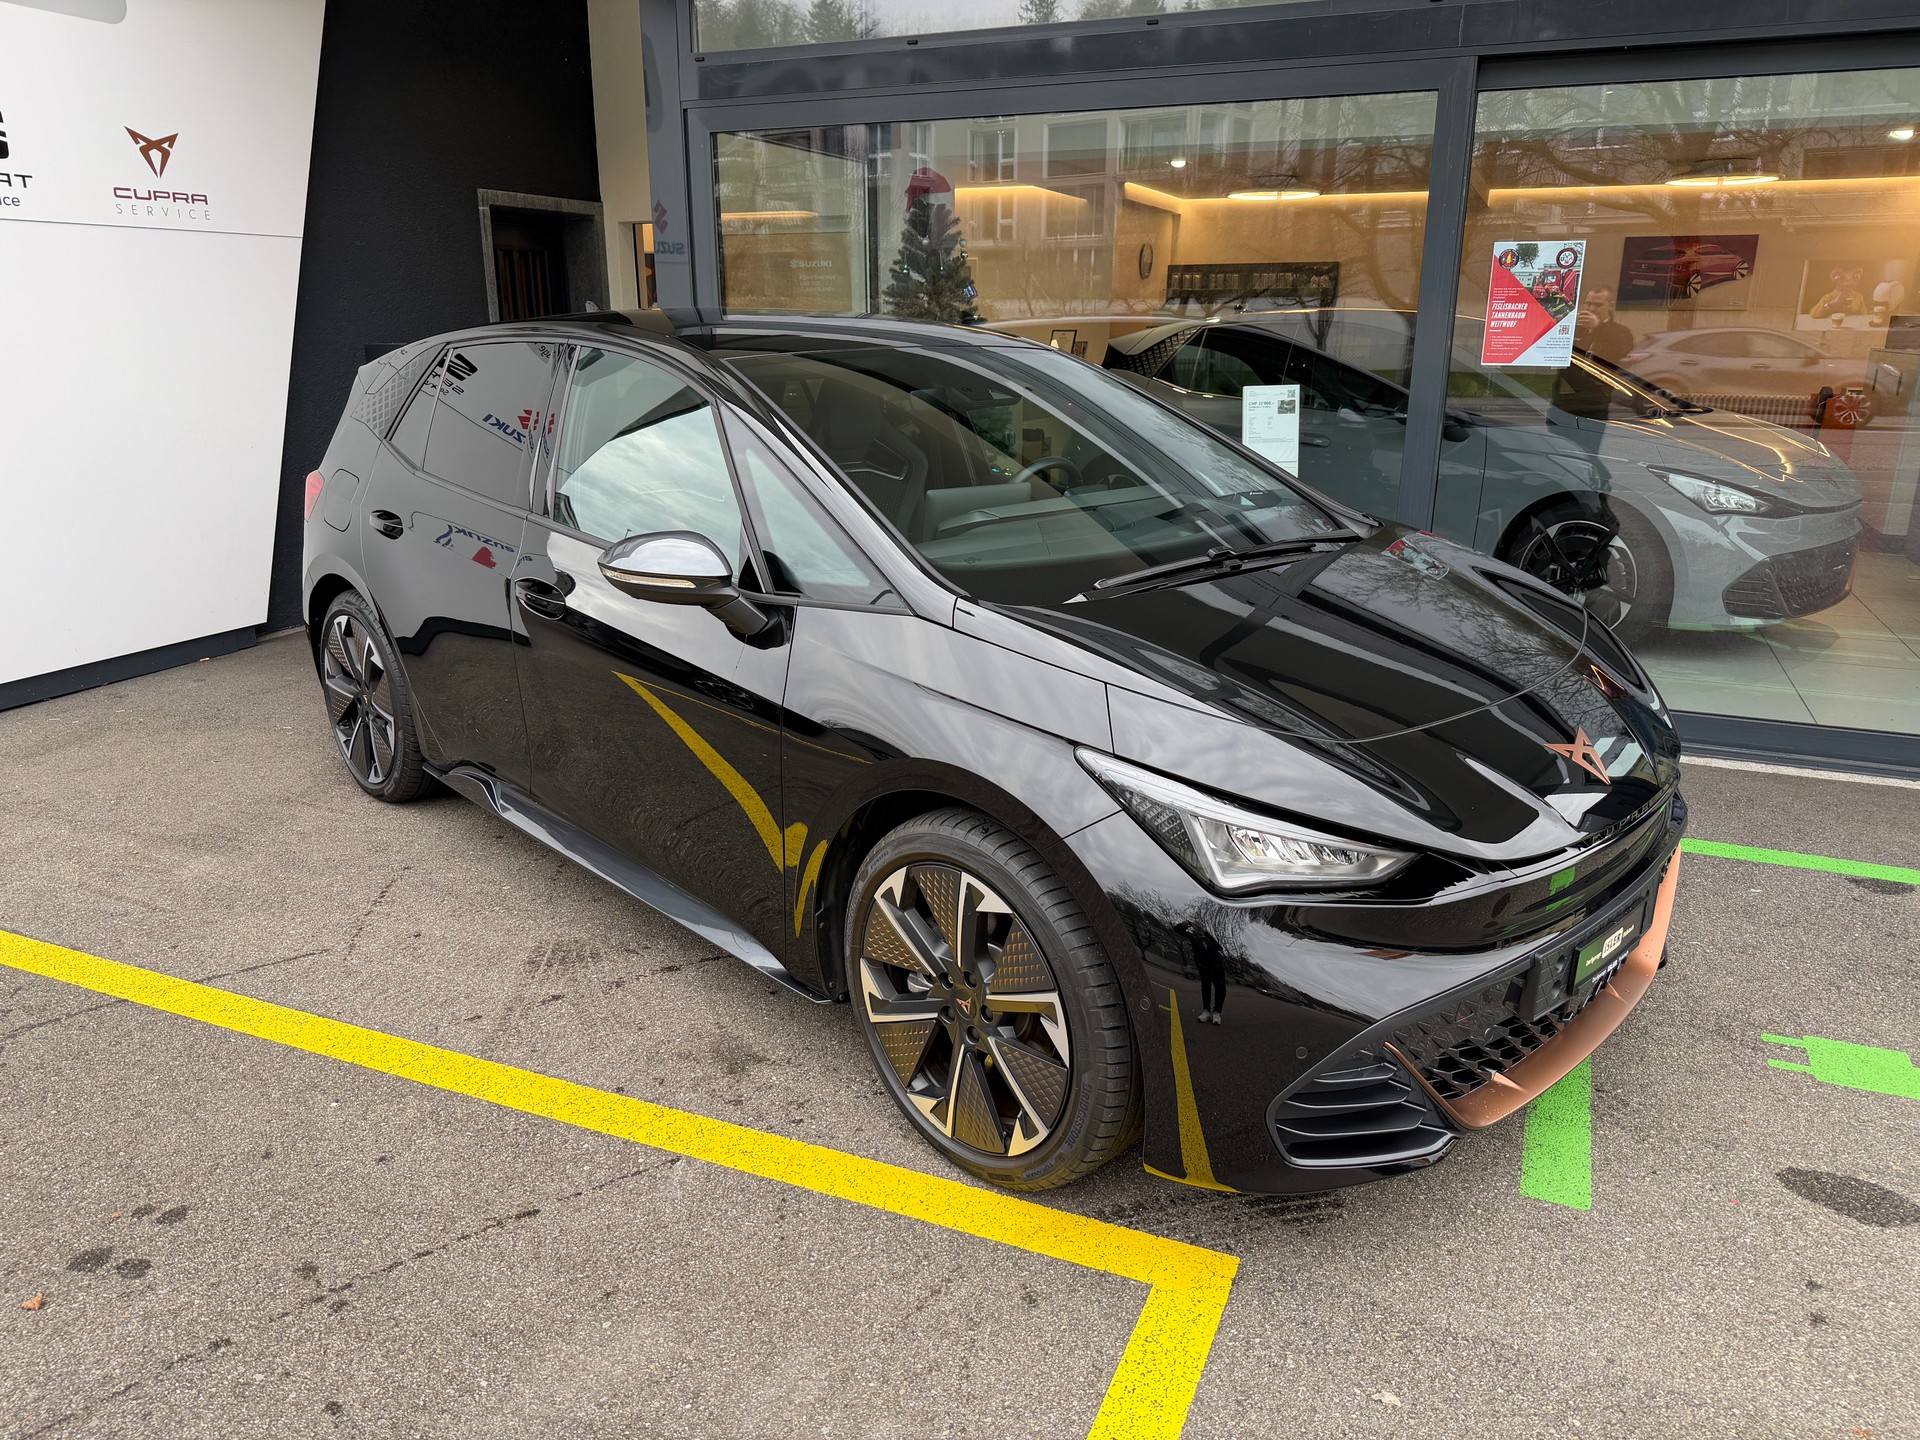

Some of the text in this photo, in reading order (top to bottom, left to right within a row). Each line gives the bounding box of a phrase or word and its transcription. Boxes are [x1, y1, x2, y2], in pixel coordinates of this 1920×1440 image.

[113, 186, 208, 205] CUPRA
[116, 203, 211, 221] SERVICE
[799, 259, 832, 268] SUZUKI
[1491, 311, 1527, 319] TANNENBAUM
[1490, 320, 1518, 328] WEITWURF
[1064, 1083, 1092, 1149] BRIDGESTONE
